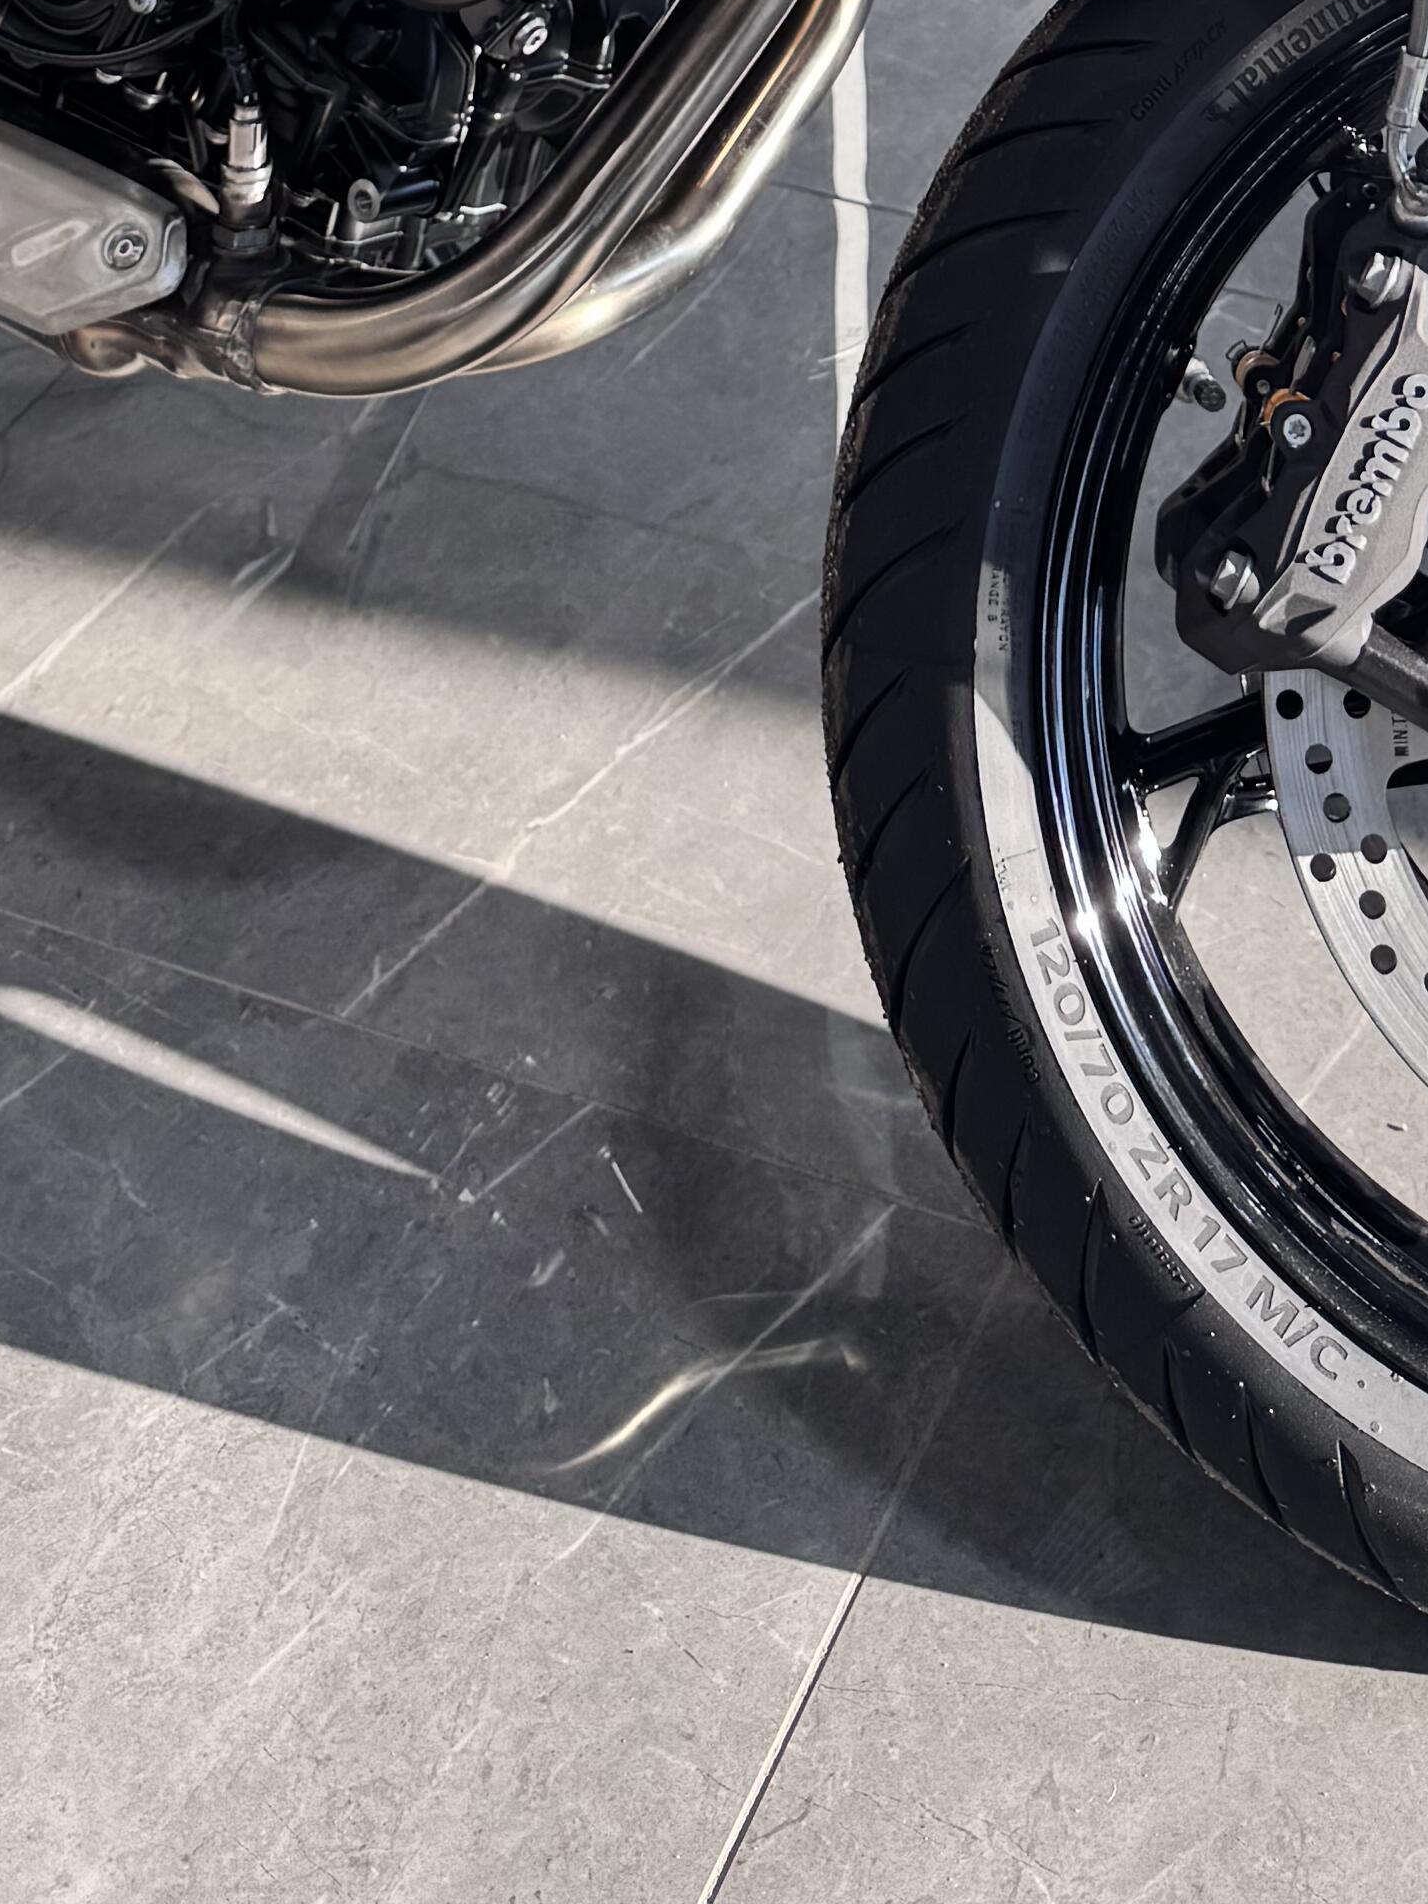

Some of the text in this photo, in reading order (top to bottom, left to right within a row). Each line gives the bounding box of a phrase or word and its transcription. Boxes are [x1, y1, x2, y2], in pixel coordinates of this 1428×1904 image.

[1029, 918, 1135, 1127] 120/70
[1128, 1131, 1194, 1222] ZR
[1191, 1212, 1248, 1274] 17
[1246, 1280, 1349, 1382] M/C
